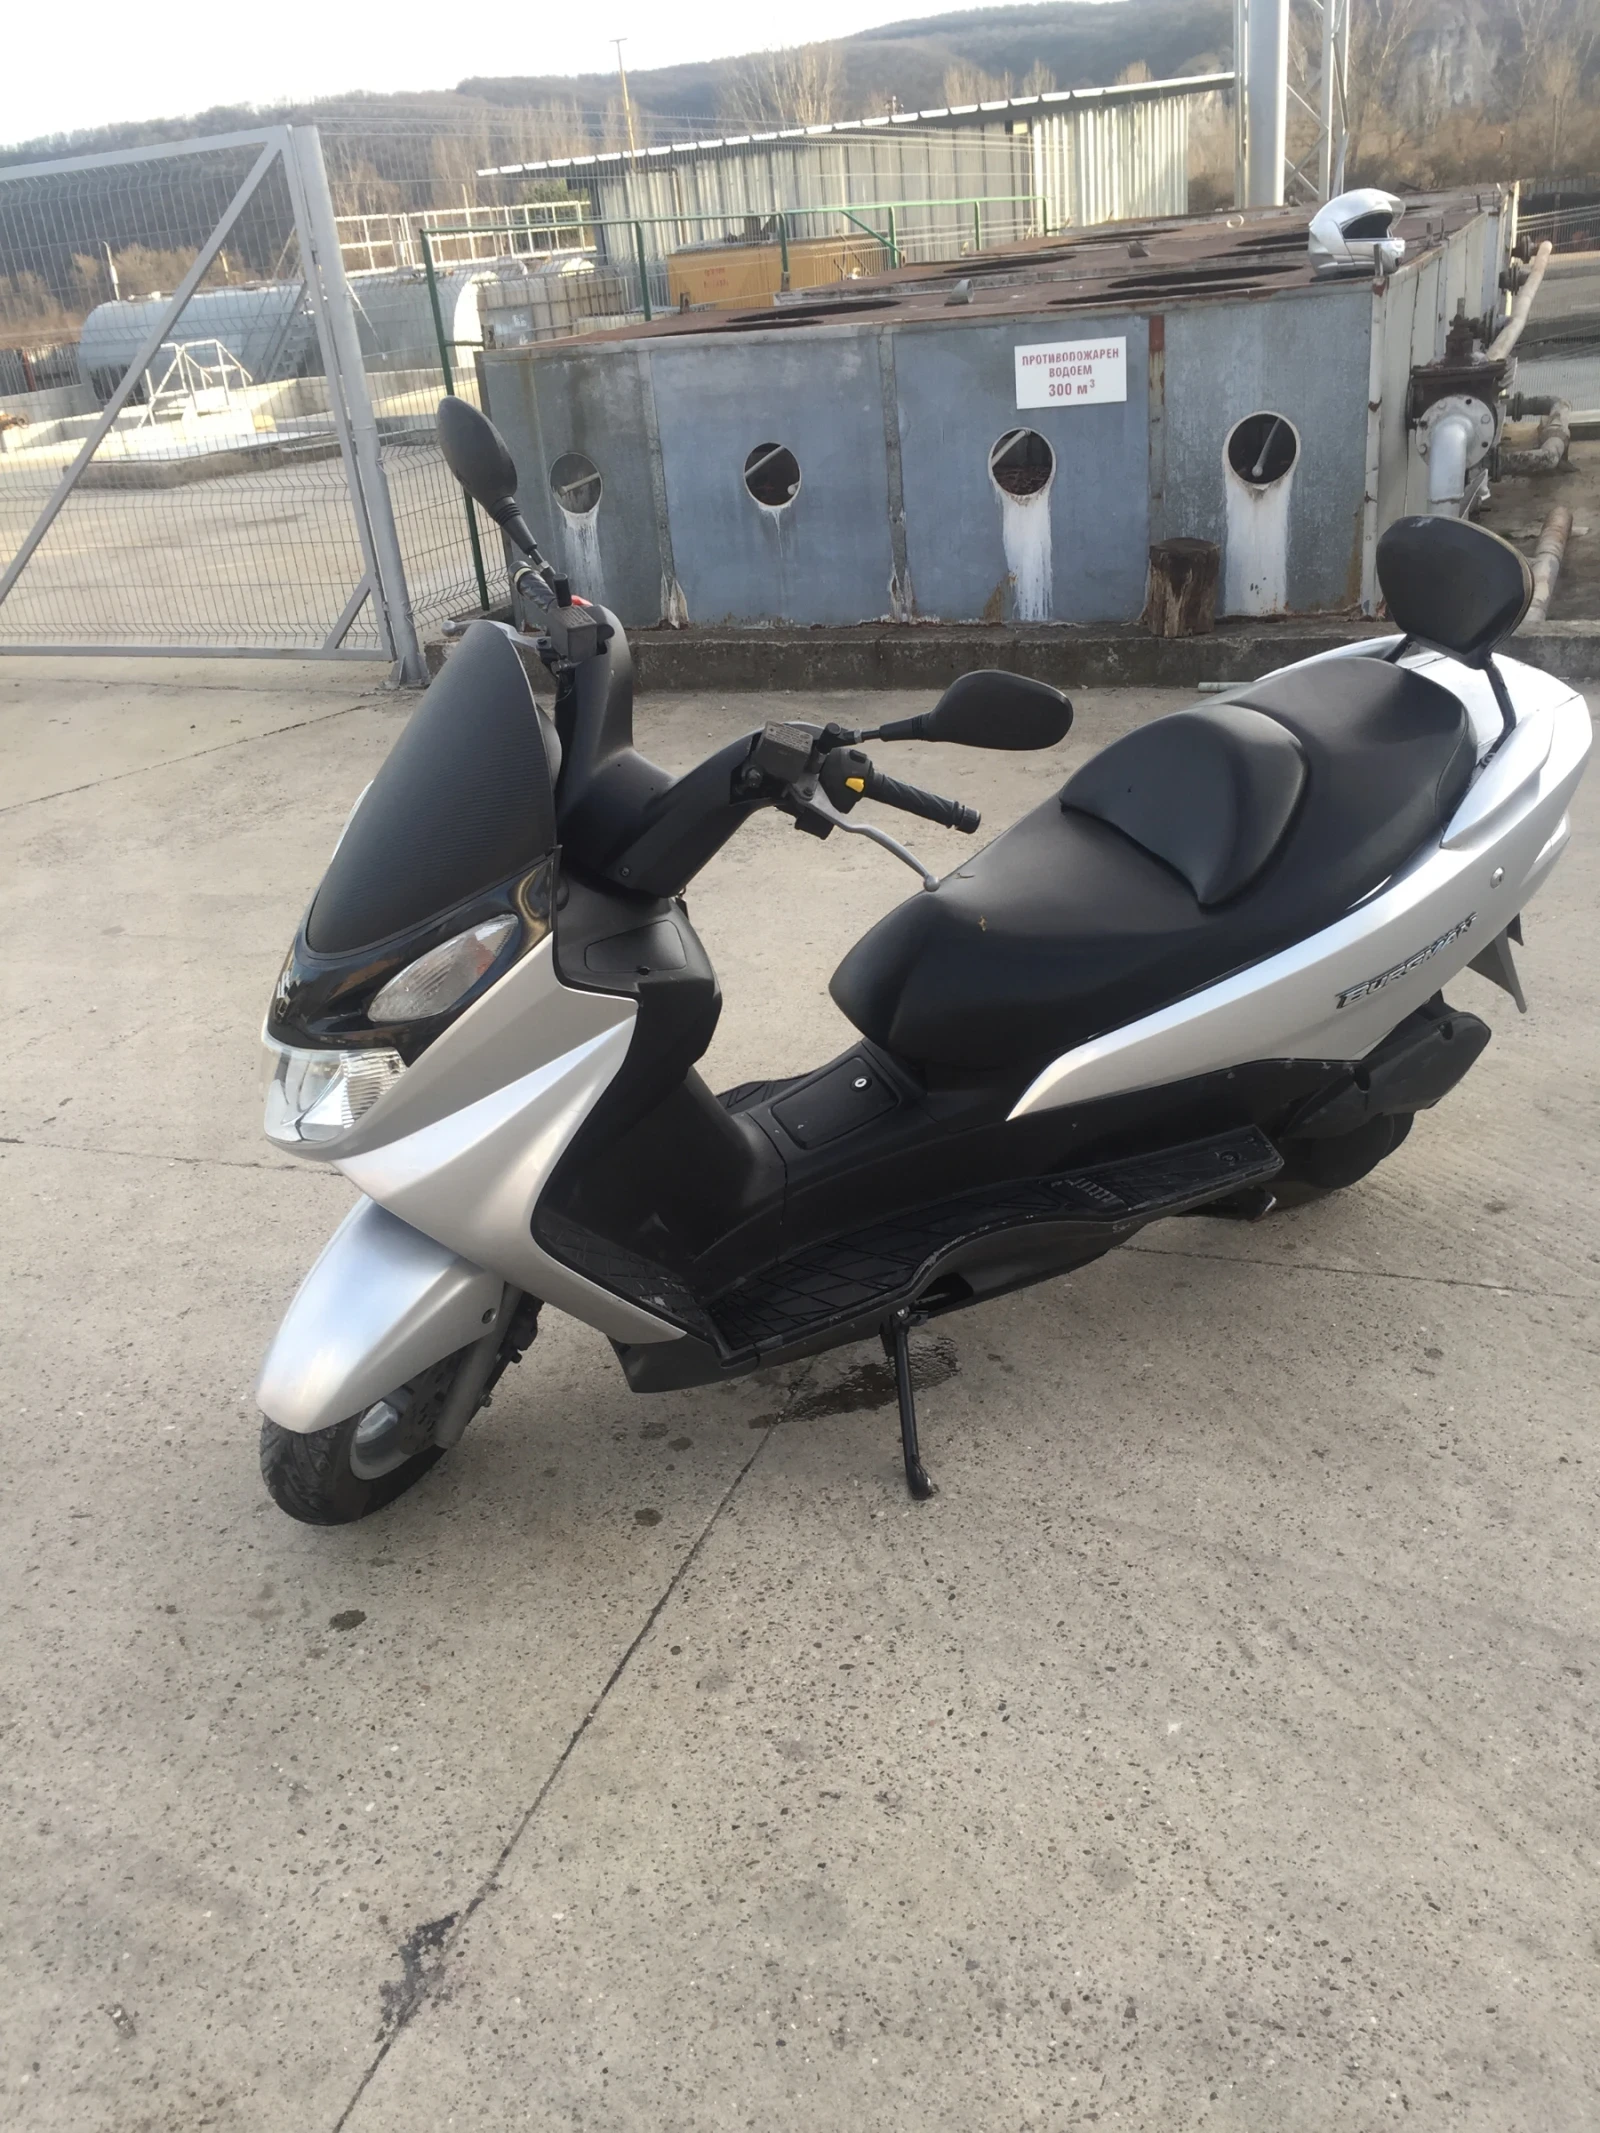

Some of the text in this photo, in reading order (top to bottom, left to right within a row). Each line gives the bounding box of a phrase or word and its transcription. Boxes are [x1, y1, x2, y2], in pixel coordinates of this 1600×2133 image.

[1022, 348, 1119, 366] ПРОТИВОПОЖАРЕН
[1049, 364, 1092, 378] ВОДОЕМ
[1048, 383, 1072, 397] 300
[1335, 911, 1478, 1009] BURGMAN
